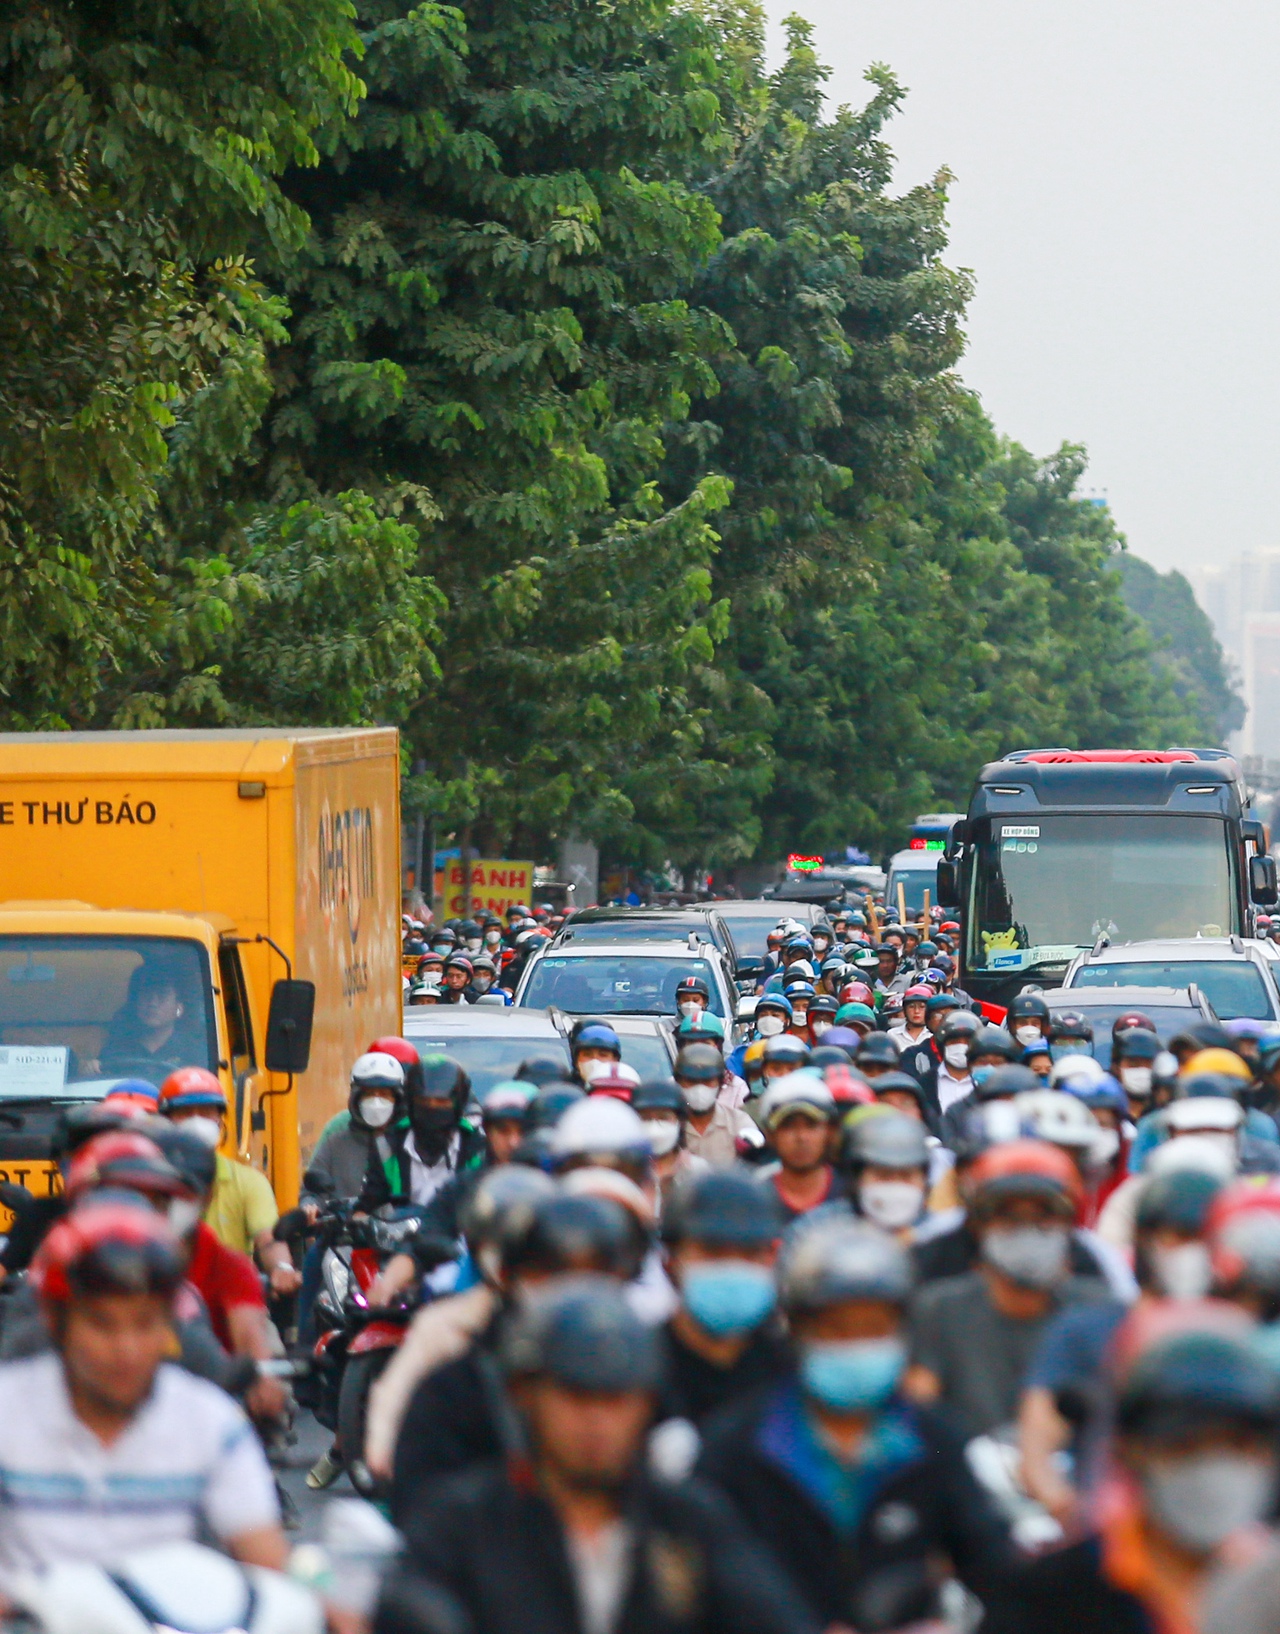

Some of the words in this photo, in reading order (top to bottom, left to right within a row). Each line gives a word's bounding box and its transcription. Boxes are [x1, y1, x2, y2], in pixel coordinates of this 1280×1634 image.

[22, 797, 89, 825] THƯ
[95, 793, 157, 825] BÁO
[450, 863, 526, 888] BÁNH
